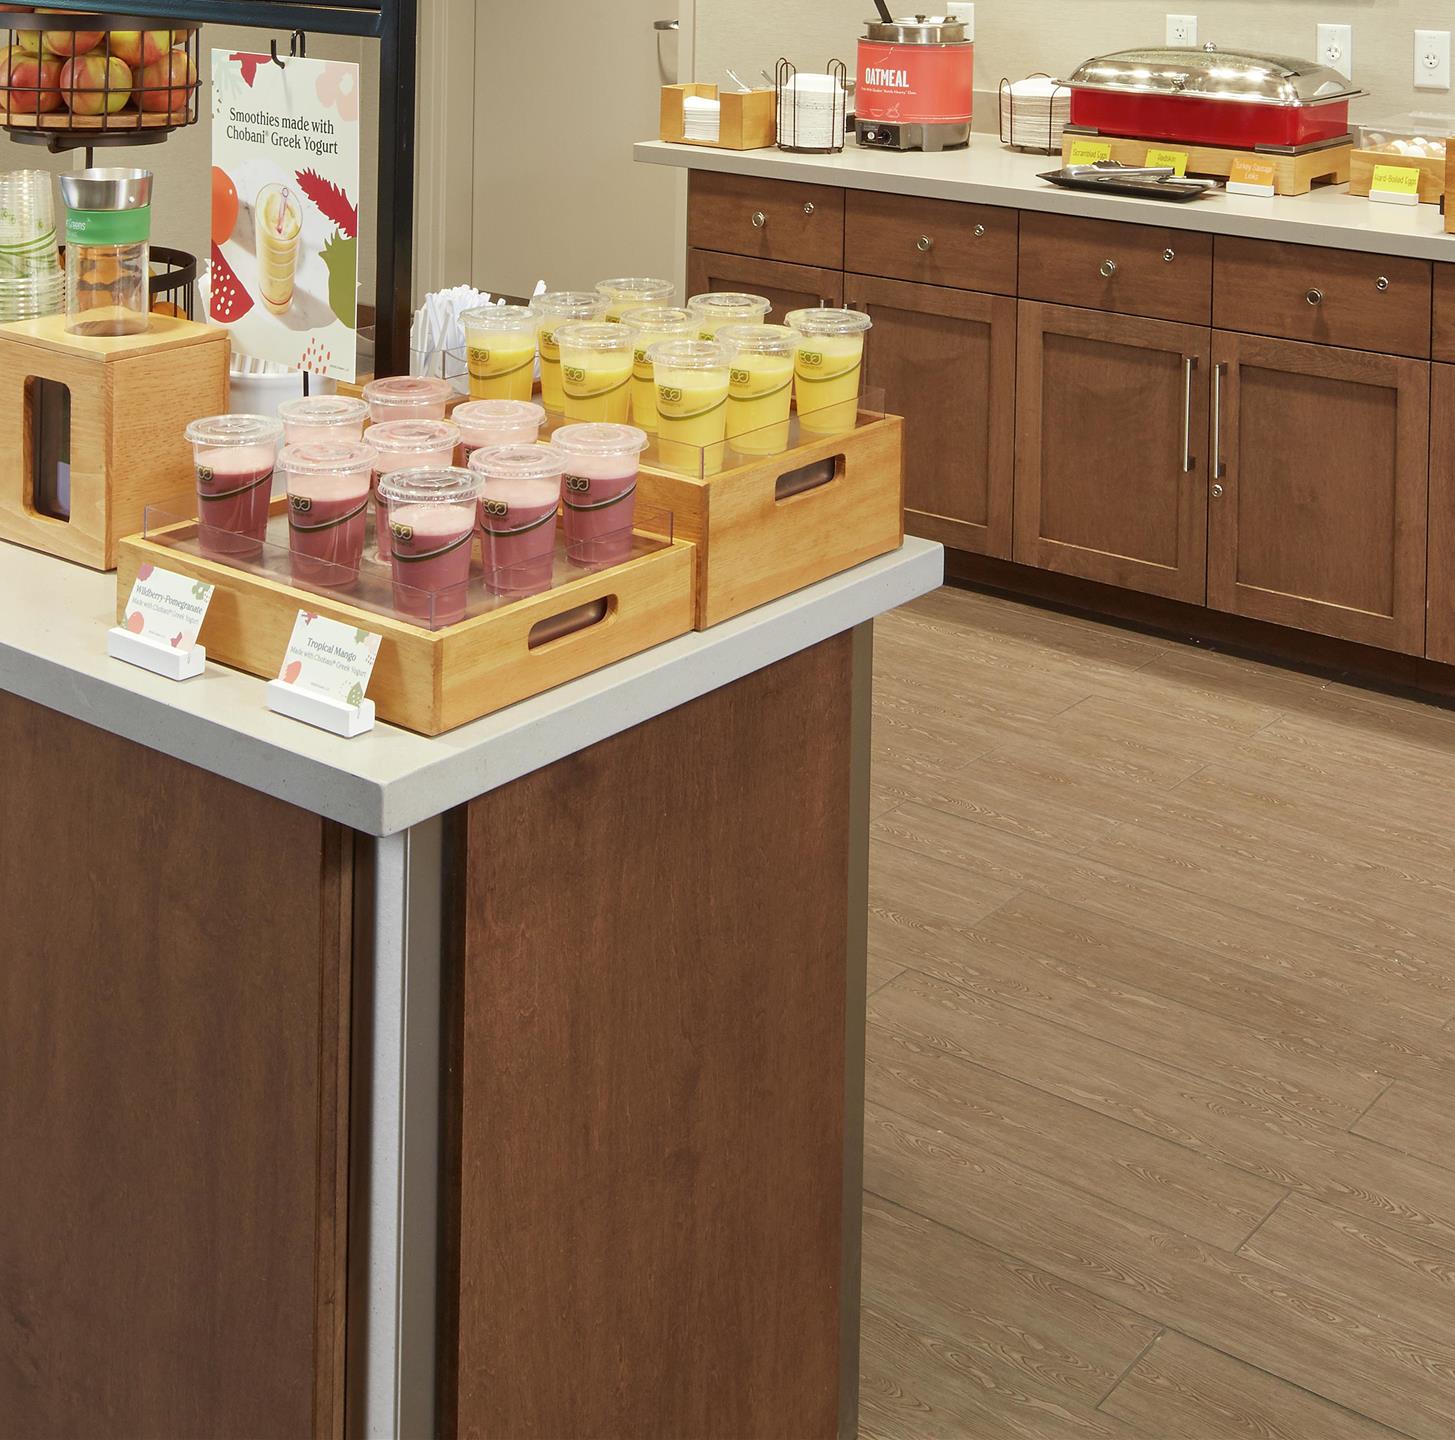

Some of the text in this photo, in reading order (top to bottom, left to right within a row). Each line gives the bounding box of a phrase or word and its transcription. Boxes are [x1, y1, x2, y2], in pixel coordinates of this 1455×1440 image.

[865, 67, 909, 87] OATMEAL
[229, 107, 334, 135] Smoothies made with
[271, 131, 301, 149] Greek
[303, 136, 338, 156] Yogurt
[799, 350, 823, 366] ECO
[659, 386, 683, 402] ECO
[566, 475, 590, 491] ECO
[307, 637, 357, 663] Tropical Mango
